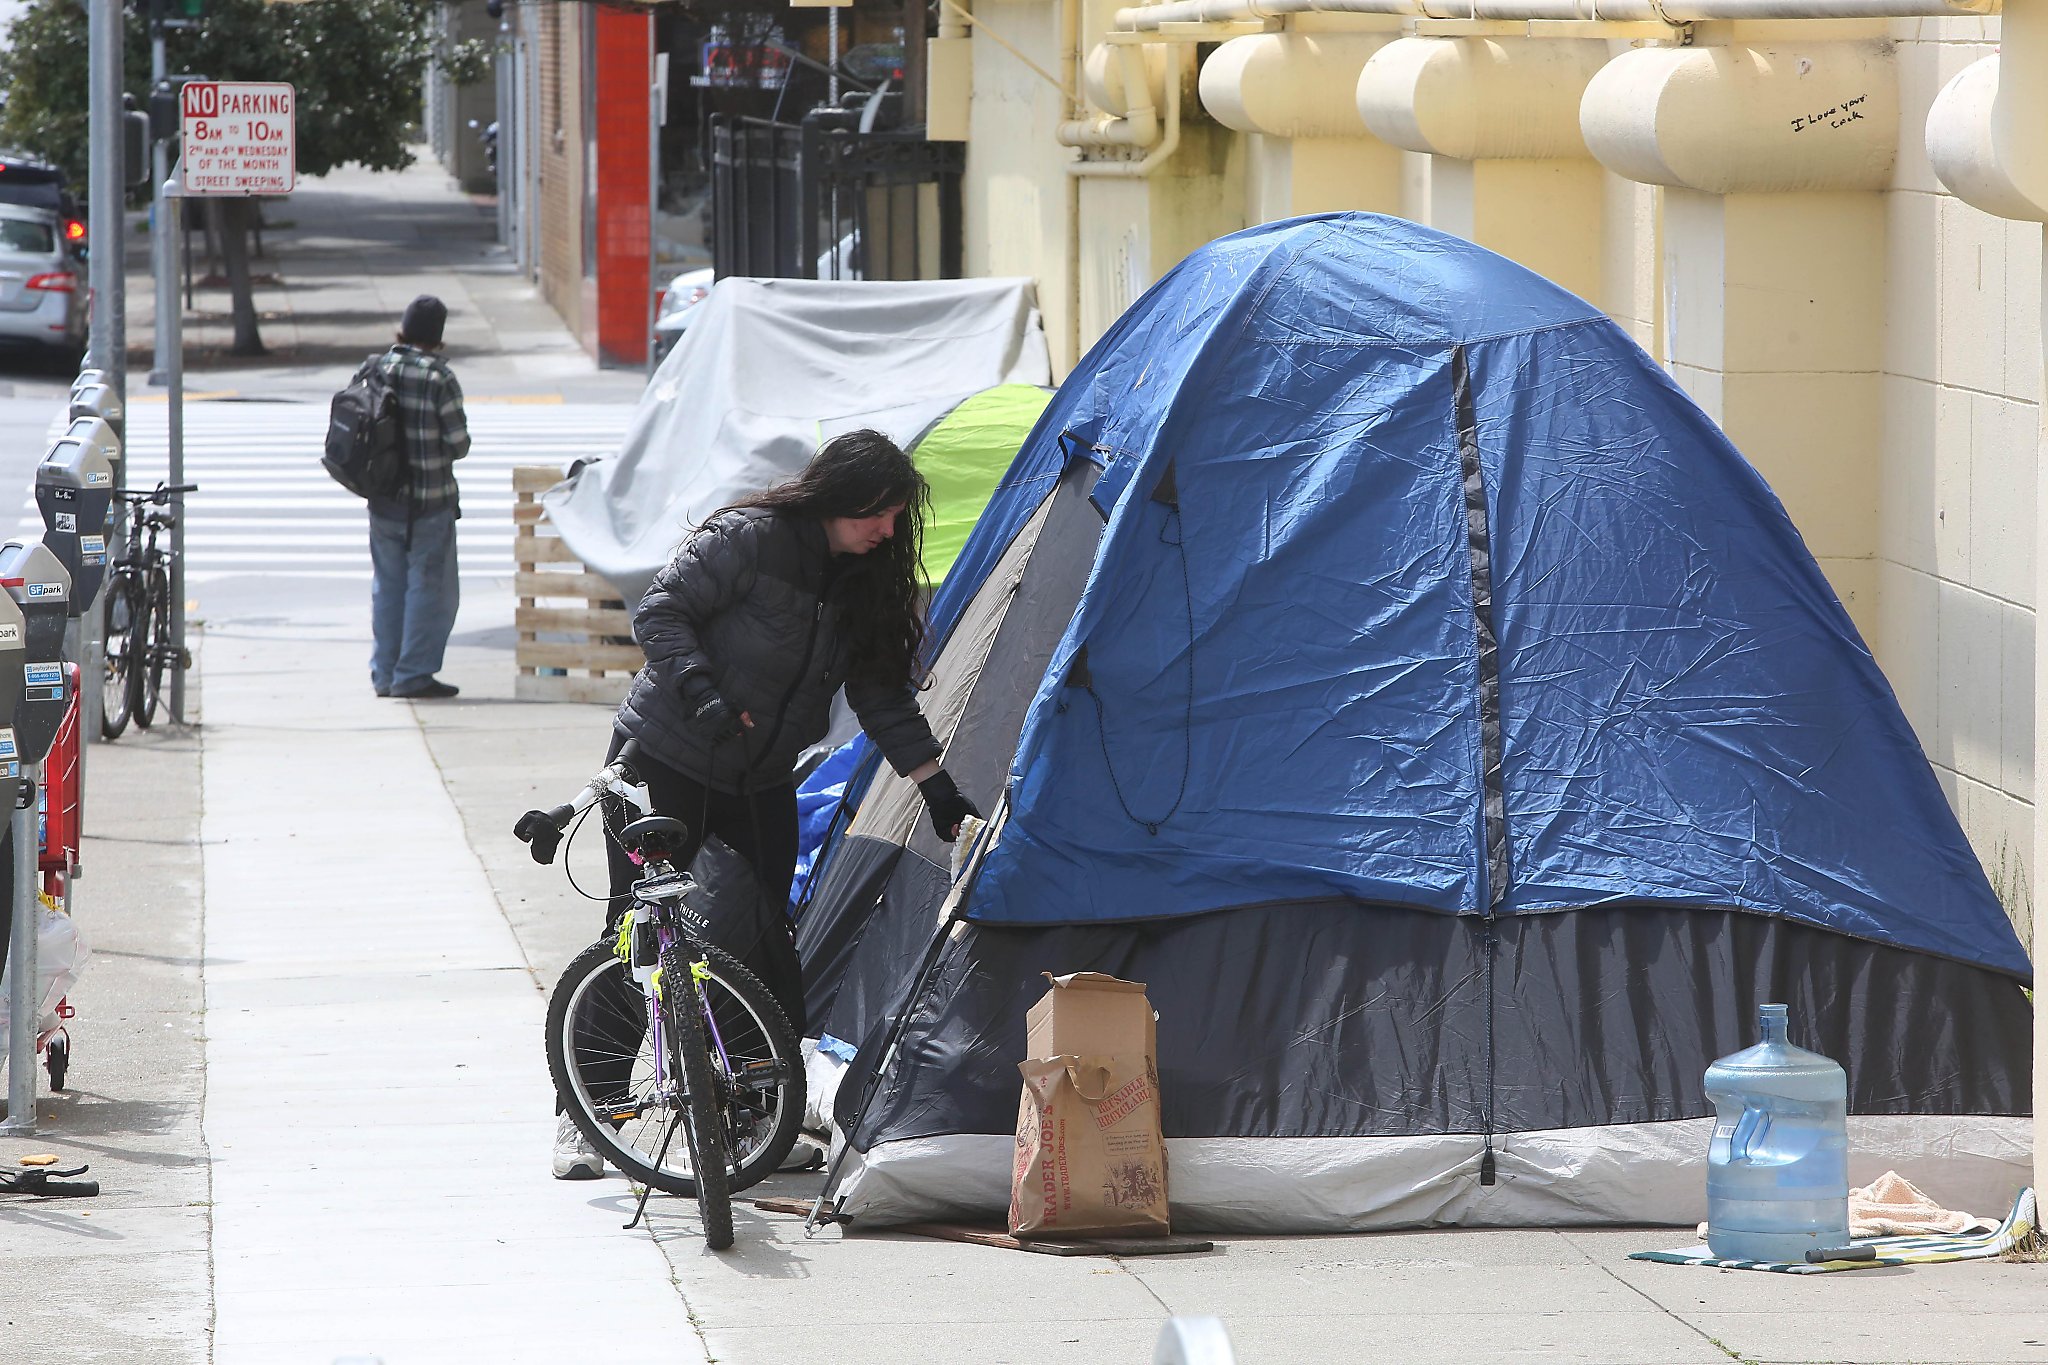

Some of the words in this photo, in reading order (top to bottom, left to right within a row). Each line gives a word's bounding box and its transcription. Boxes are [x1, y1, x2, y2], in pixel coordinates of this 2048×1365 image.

[187, 87, 215, 114] NO
[222, 94, 289, 114] PARKING
[195, 121, 222, 140] 8AM
[229, 125, 239, 135] TO
[247, 121, 283, 141] 10AM
[1791, 118, 1804, 132] I
[1808, 108, 1836, 124] Love
[205, 148, 219, 156] AND
[238, 146, 288, 156] WEDNESDAY
[199, 160, 211, 169] OF
[218, 160, 237, 169] THE
[243, 160, 279, 169] MONTH
[195, 176, 230, 187] STREET
[235, 176, 284, 187] SWEEPING
[680, 902, 710, 928] THISTLE
[1097, 1077, 1146, 1114] REUSABLE
[1042, 1159, 1057, 1226] TRADER
